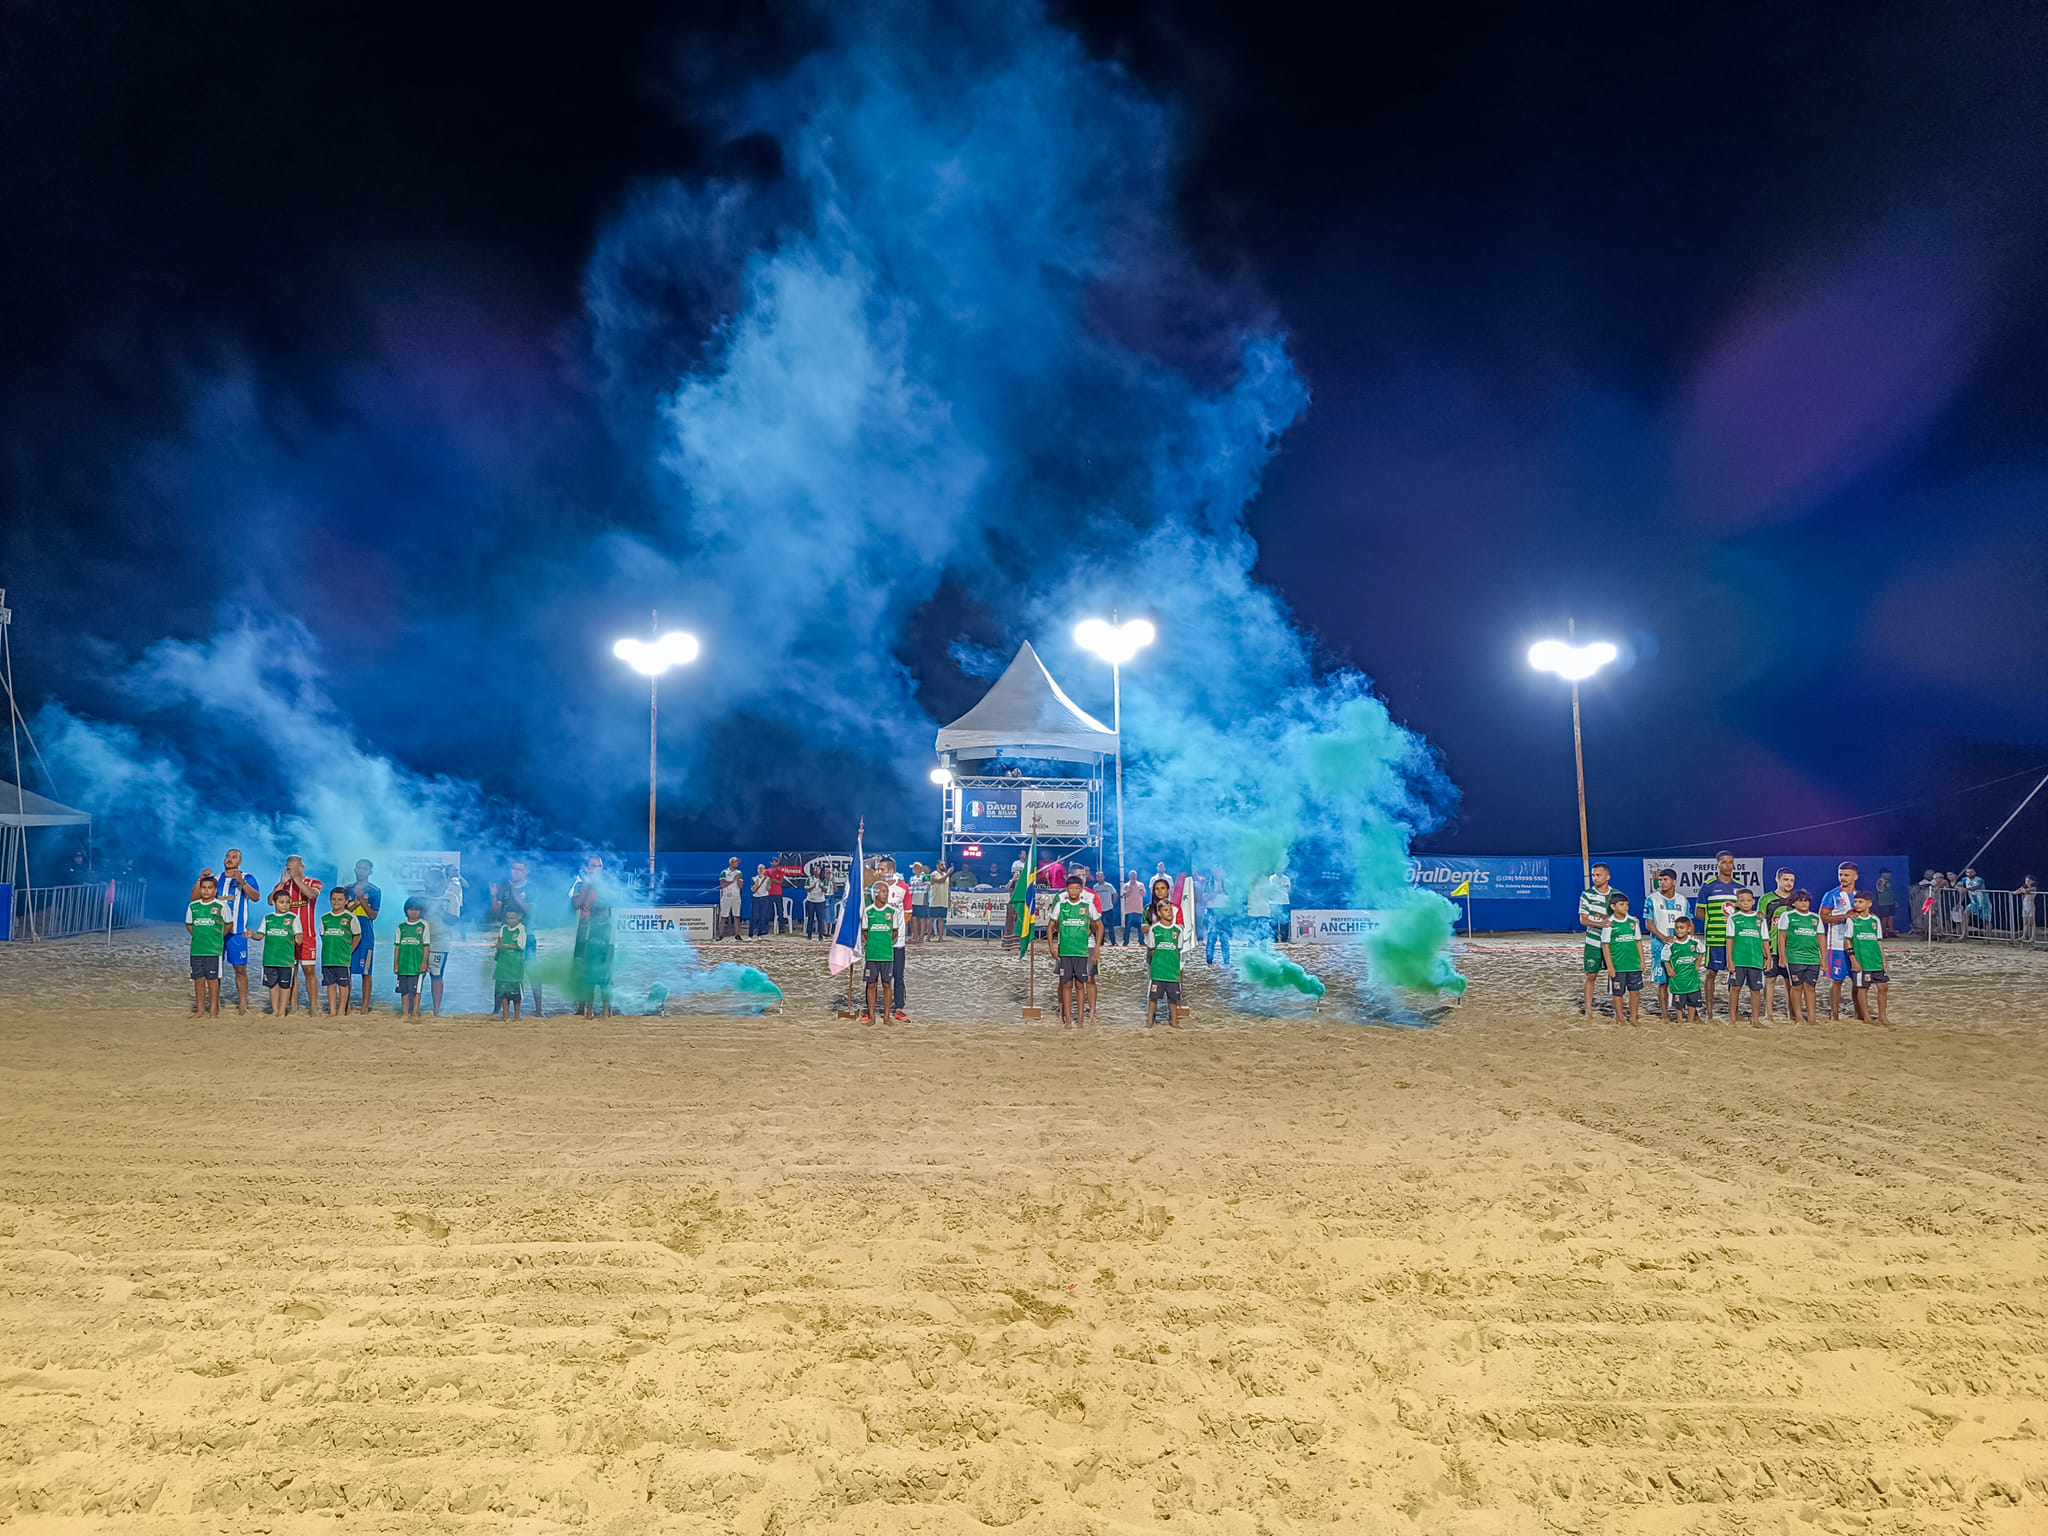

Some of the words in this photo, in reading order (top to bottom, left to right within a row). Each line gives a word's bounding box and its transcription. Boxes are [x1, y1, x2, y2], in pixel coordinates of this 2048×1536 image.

[1025, 800, 1054, 809] ARENA
[1056, 799, 1084, 810] VERÃO
[1405, 866, 1490, 884] OralDents
